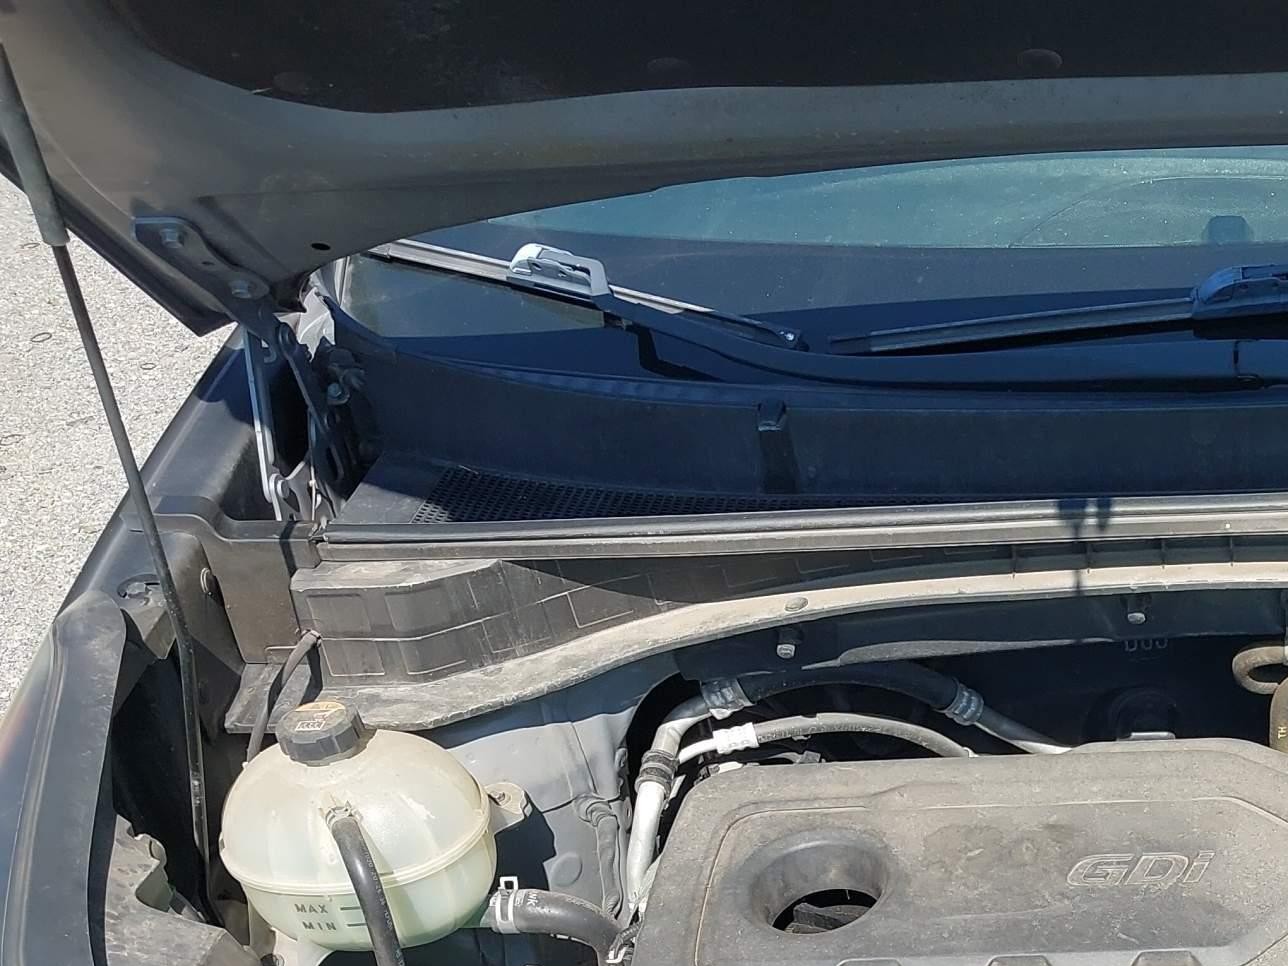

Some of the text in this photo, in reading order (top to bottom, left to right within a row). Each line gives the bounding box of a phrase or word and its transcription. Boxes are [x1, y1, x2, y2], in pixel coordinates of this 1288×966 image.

[1277, 726, 1288, 739] TH
[294, 903, 329, 914] MAX
[302, 921, 337, 931] MIN
